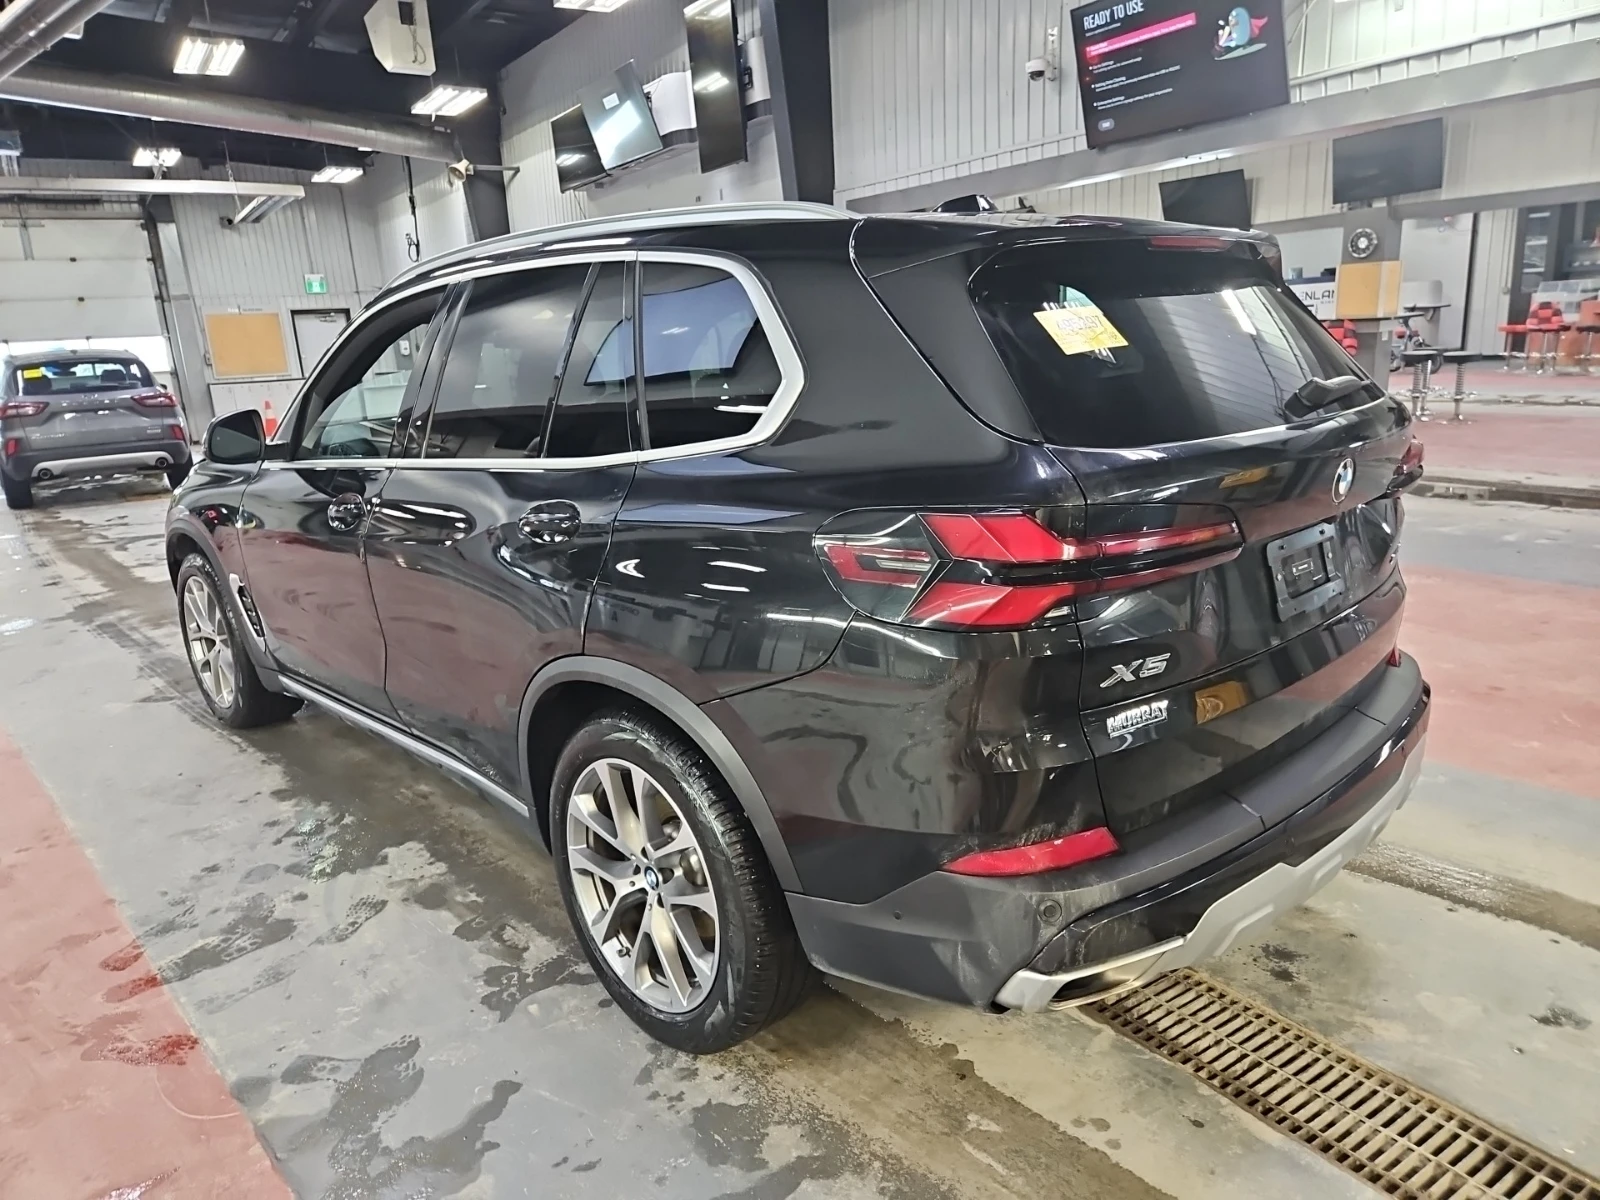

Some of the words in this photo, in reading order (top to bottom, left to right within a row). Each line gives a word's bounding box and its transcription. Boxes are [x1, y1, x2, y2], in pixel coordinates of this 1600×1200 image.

[1083, 8, 1111, 30] READY
[1112, 4, 1125, 20] TO
[1126, 0, 1145, 15] USE
[1099, 652, 1171, 688] X5
[1106, 699, 1169, 734] MURRAY
